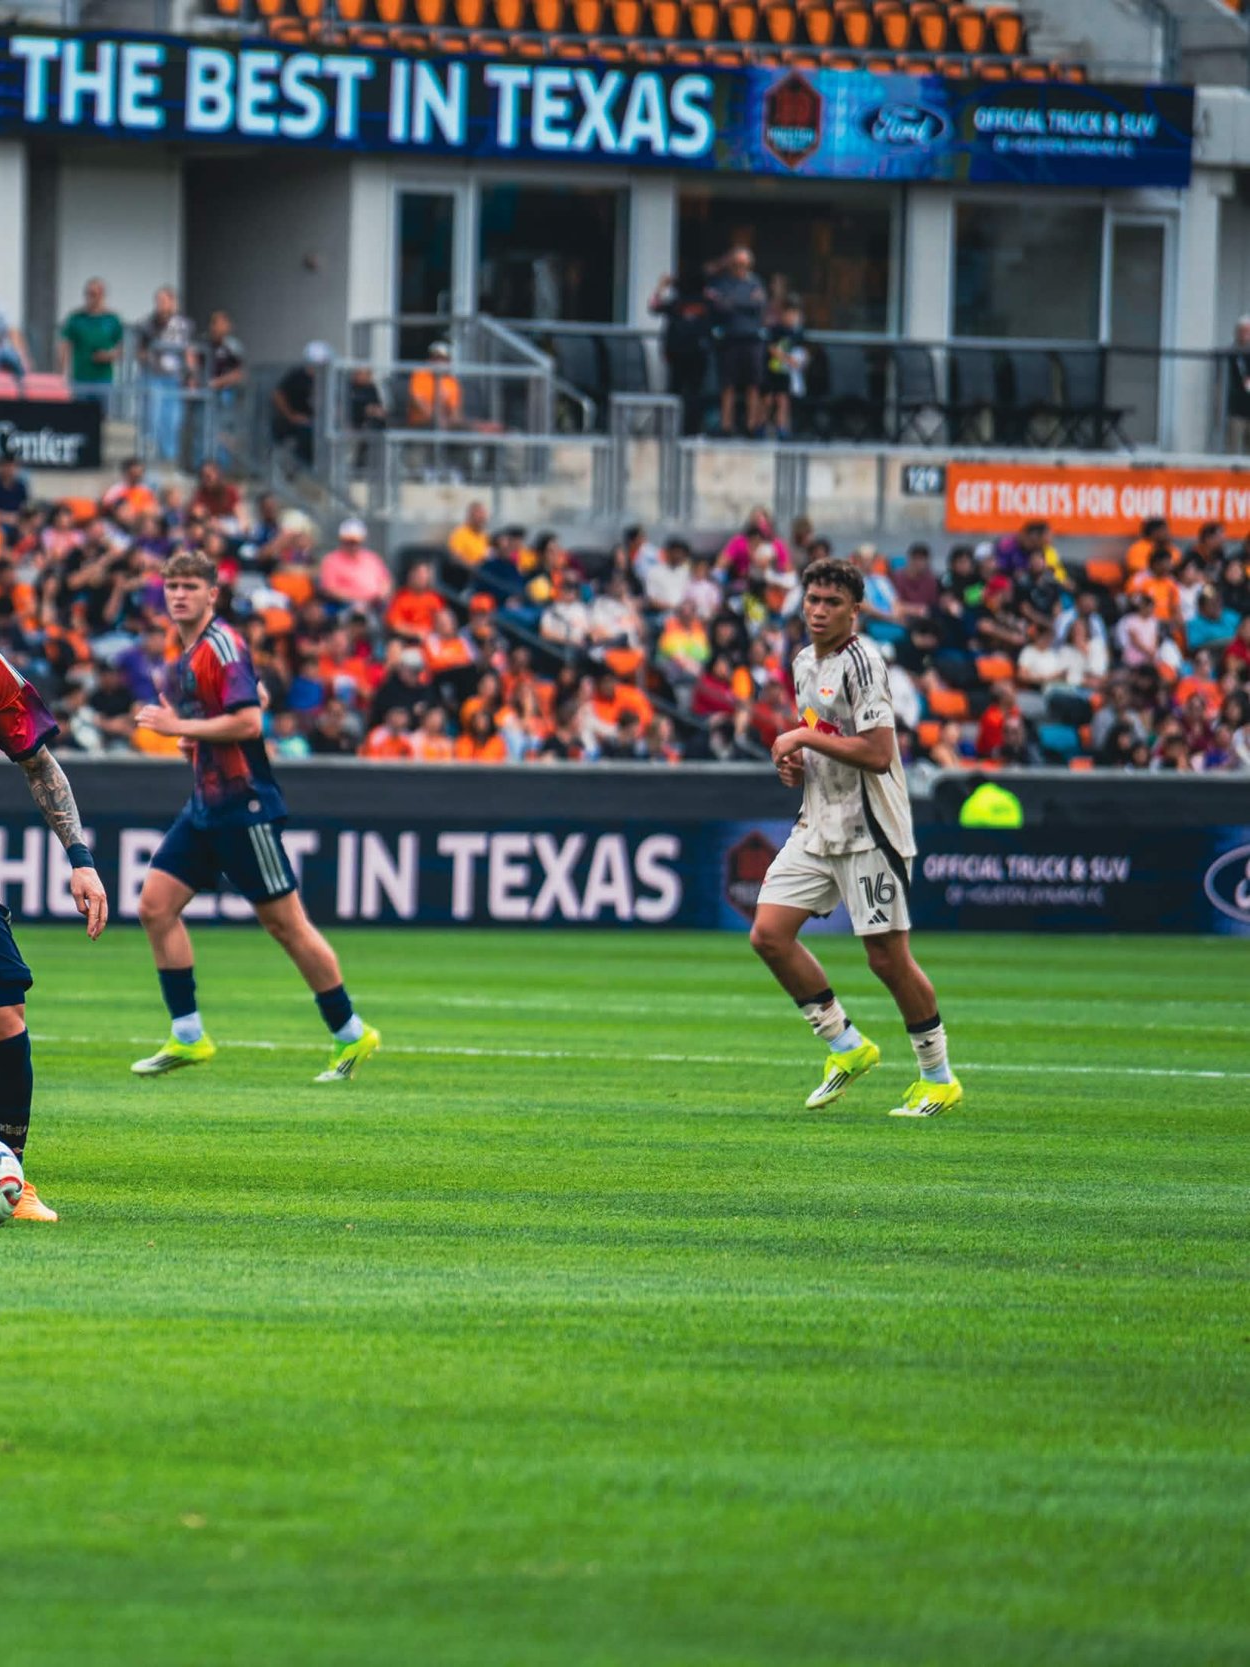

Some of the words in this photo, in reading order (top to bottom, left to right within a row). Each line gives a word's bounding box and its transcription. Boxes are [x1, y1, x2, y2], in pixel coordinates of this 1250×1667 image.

[10, 35, 165, 129] THE
[185, 47, 374, 139] BEST
[389, 58, 467, 146] IN
[484, 64, 715, 158] TEXAS
[871, 106, 933, 145] Ford
[973, 106, 1045, 134] OFFICIAL
[1047, 109, 1101, 136] TRUCK
[1121, 112, 1158, 139] SUV
[907, 466, 941, 494] 129
[955, 479, 992, 515] GET
[998, 481, 1073, 519] TICKETS
[1077, 484, 1116, 519] FOR
[1120, 486, 1166, 519] OUR
[1170, 486, 1220, 520] NEXT
[335, 830, 419, 920] IN
[436, 831, 683, 922] TEXAS
[923, 854, 1004, 882] OFFICIAL
[1006, 855, 1068, 881] TRUCK
[1070, 855, 1087, 881] &
[1089, 855, 1131, 882] SUV
[859, 871, 897, 909] 16
